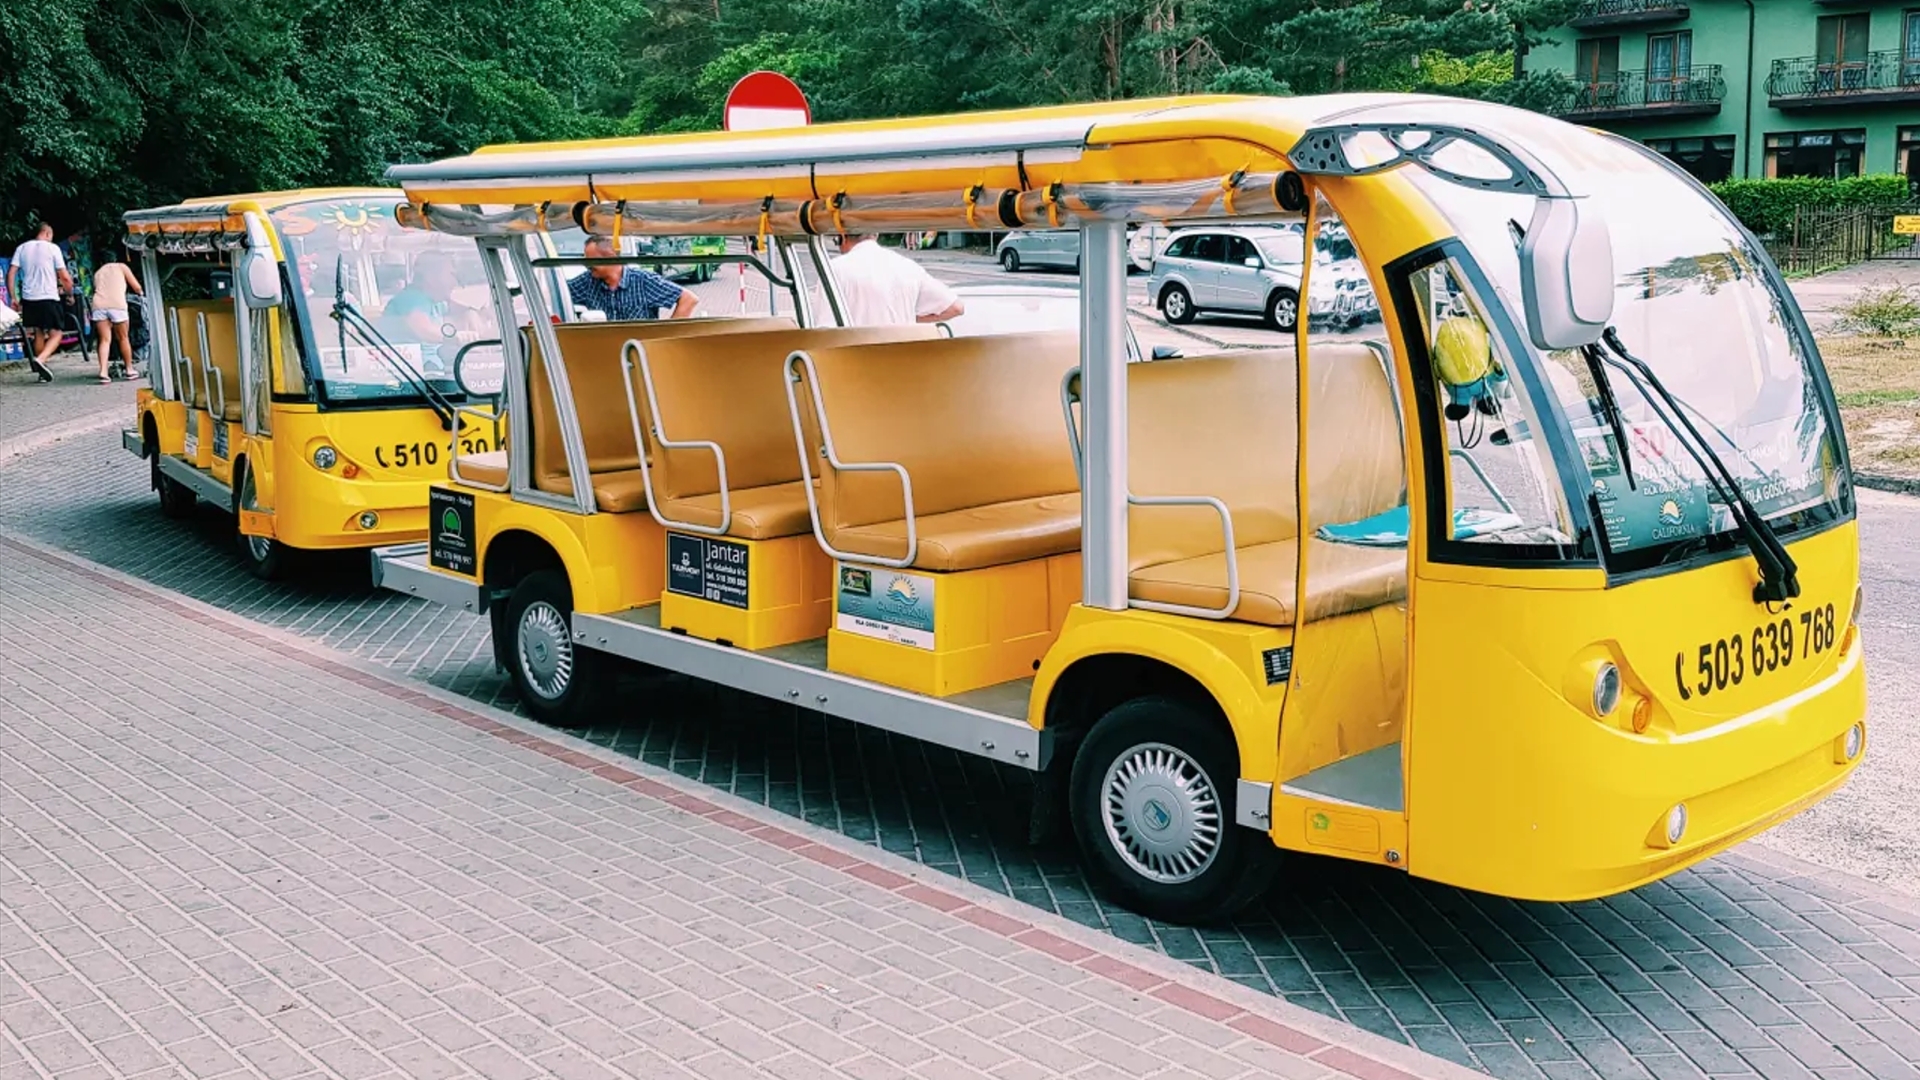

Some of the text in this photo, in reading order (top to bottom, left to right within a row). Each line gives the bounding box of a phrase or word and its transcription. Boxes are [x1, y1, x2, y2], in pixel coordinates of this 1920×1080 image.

[394, 442, 438, 467] 510
[1640, 459, 1691, 481] RABATU
[1746, 487, 1763, 503] DLA
[1652, 523, 1695, 540] CALIFORNIA
[706, 540, 747, 564] Jantar
[1697, 603, 1834, 696] 503 639 768
